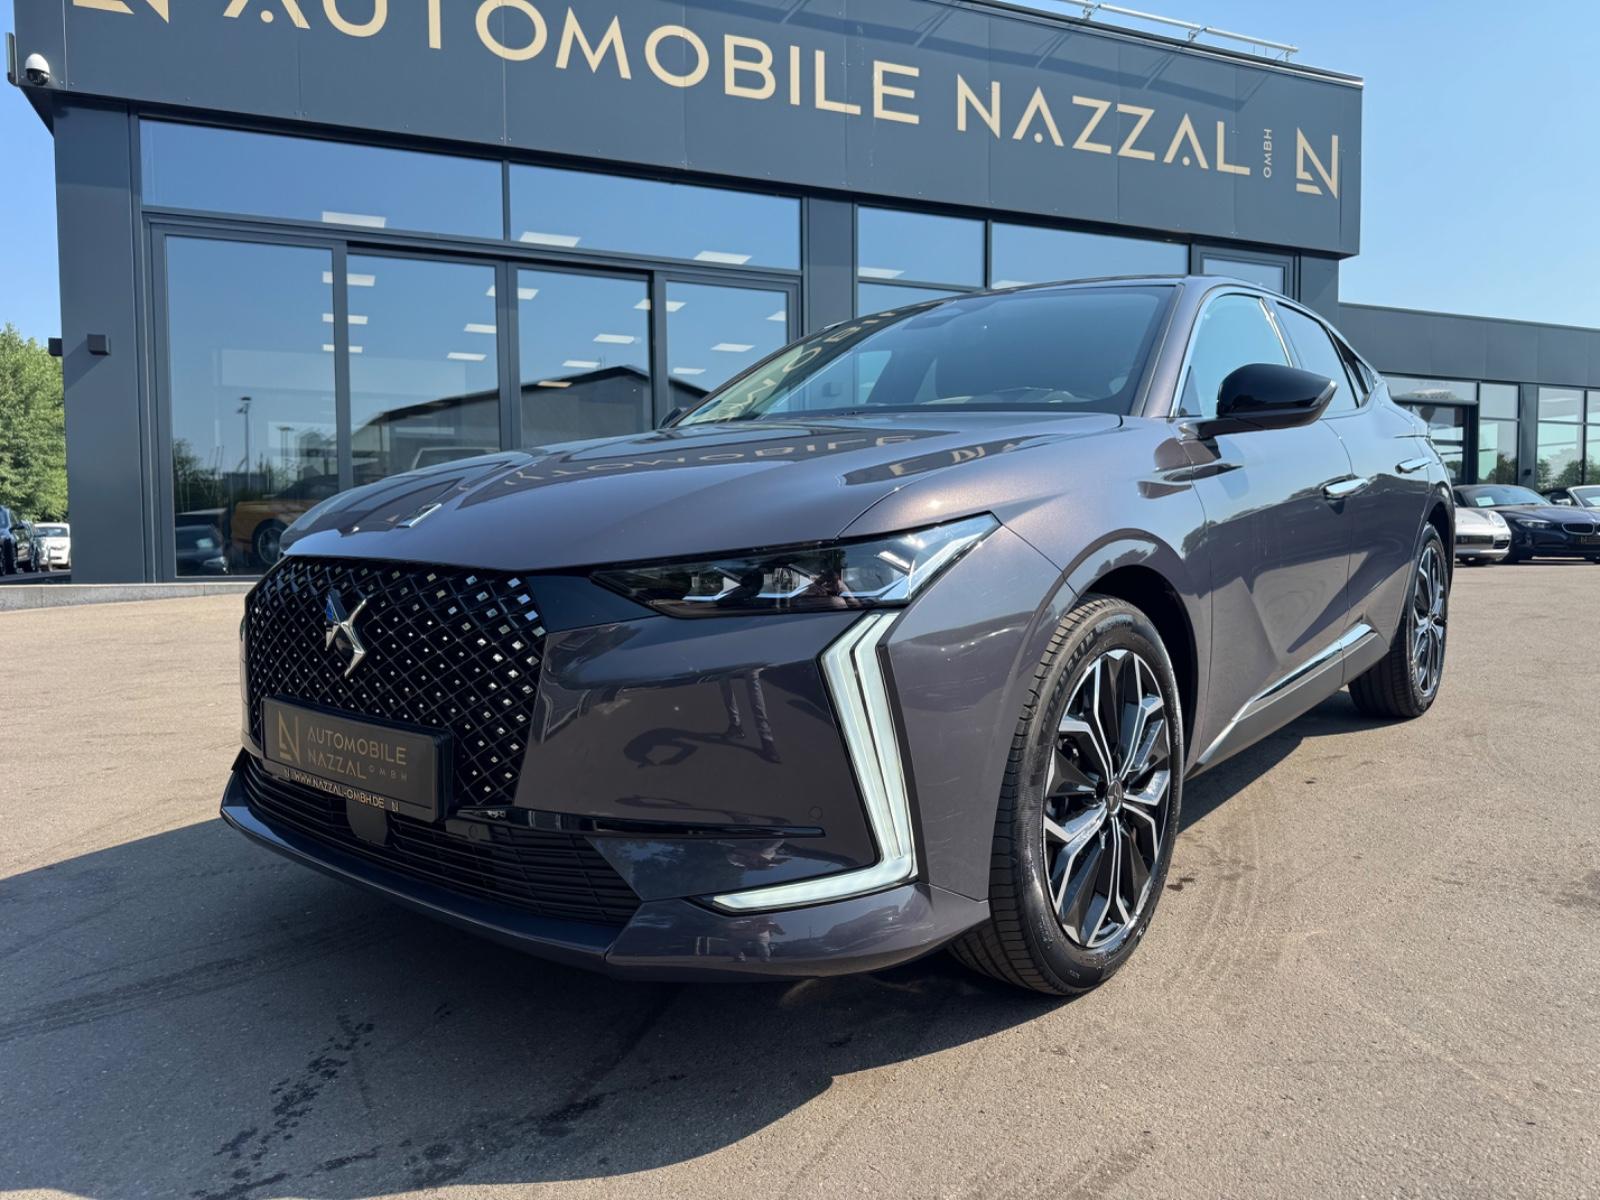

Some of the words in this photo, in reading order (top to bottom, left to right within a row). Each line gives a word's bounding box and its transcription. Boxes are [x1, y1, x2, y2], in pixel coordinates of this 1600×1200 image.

[956, 73, 1250, 176] NAZZAL
[307, 725, 407, 765] AUTOMOBILE
[307, 747, 367, 780] NAZZAL
